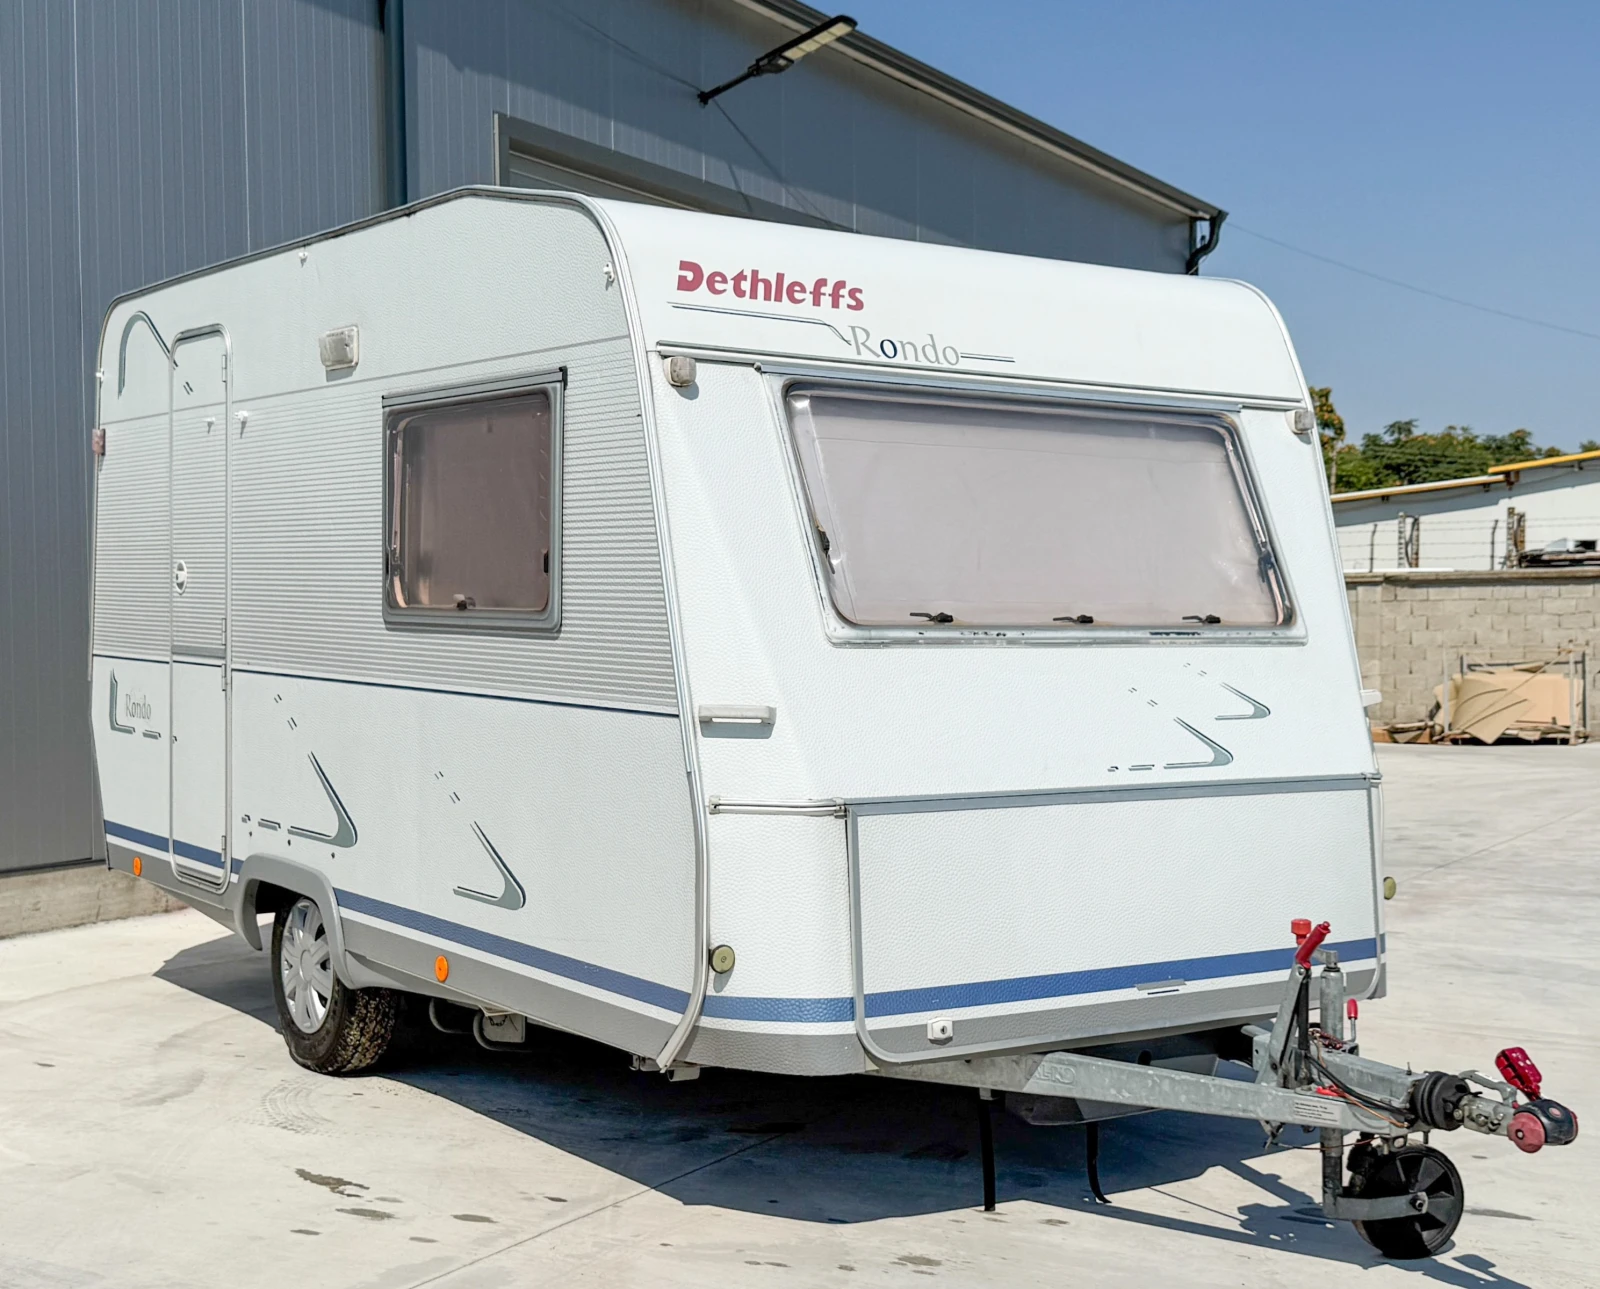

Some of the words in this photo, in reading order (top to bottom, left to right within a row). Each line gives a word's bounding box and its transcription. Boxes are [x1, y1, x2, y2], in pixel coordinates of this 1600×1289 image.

[677, 260, 864, 311] Dethleffs
[848, 325, 960, 366] Rondo
[125, 693, 152, 720] Rondo
